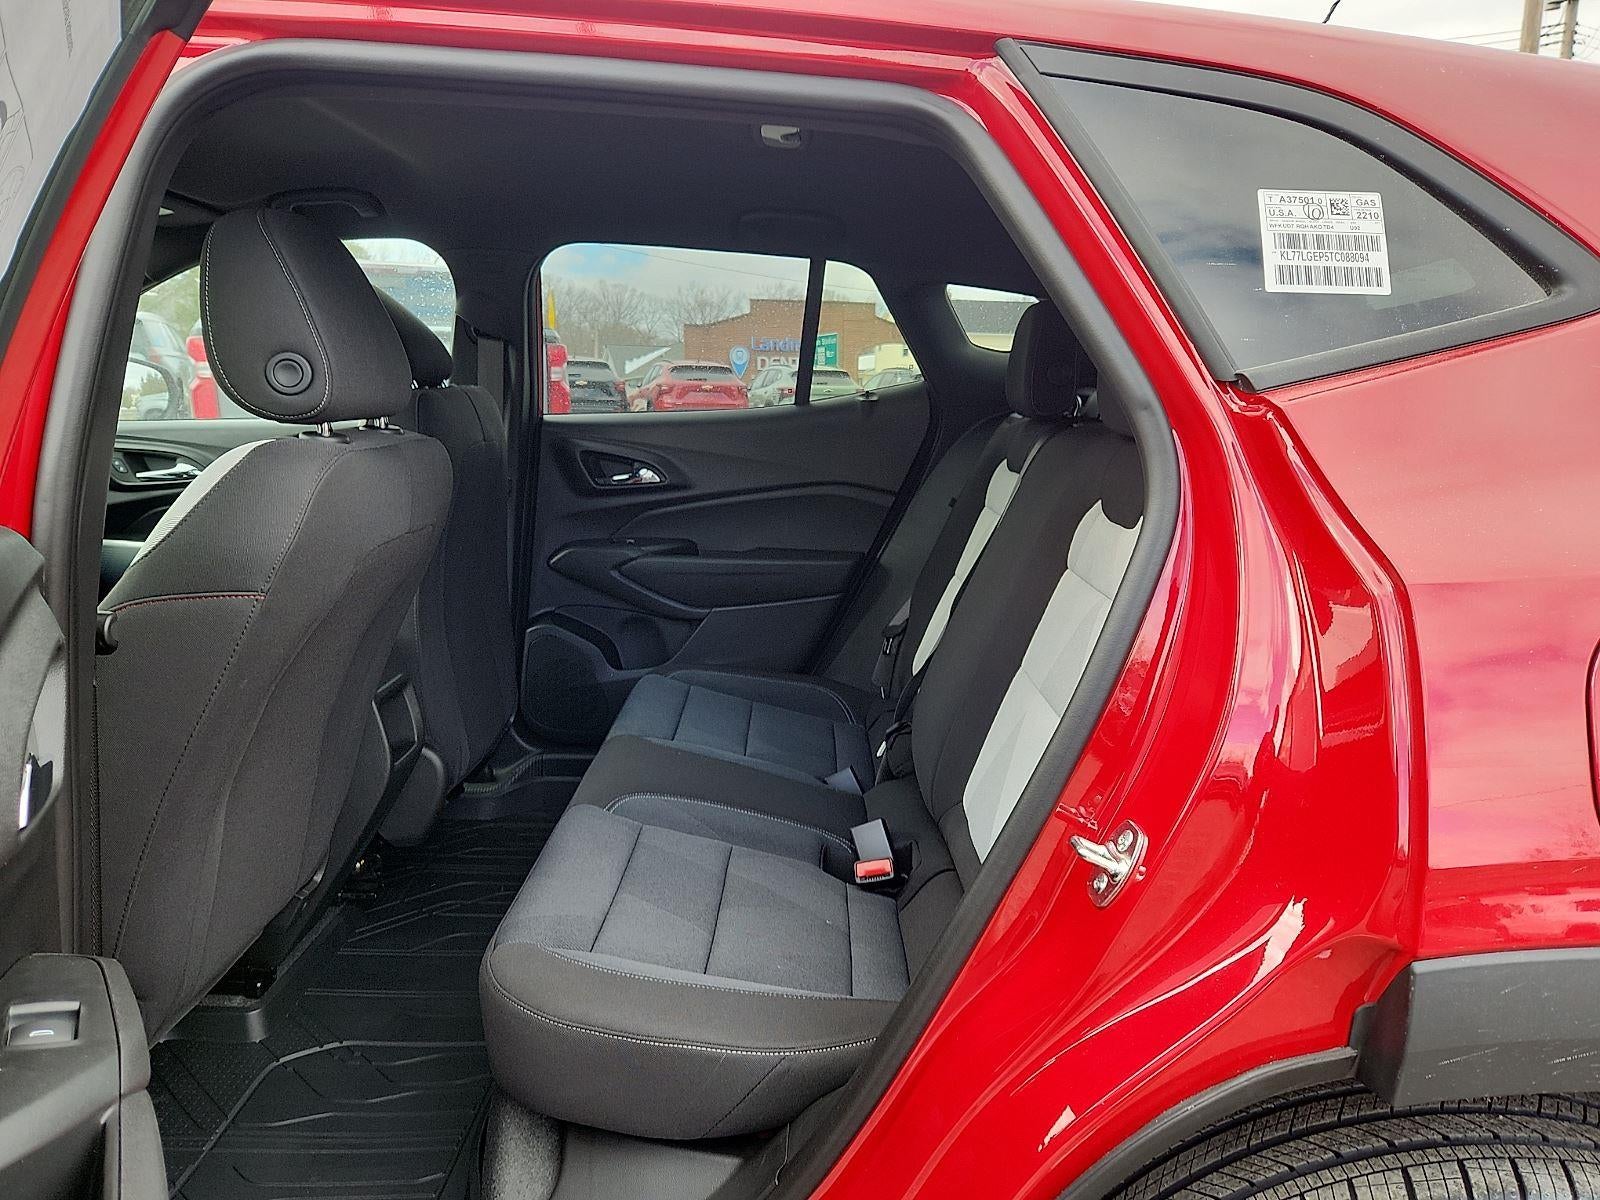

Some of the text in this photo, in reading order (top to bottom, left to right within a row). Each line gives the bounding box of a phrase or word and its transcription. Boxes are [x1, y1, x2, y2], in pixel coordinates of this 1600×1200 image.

[1279, 195, 1314, 204] A37501
[1355, 198, 1377, 207] GAS
[1268, 208, 1297, 217] U.S.A.
[1356, 211, 1380, 220] 2210
